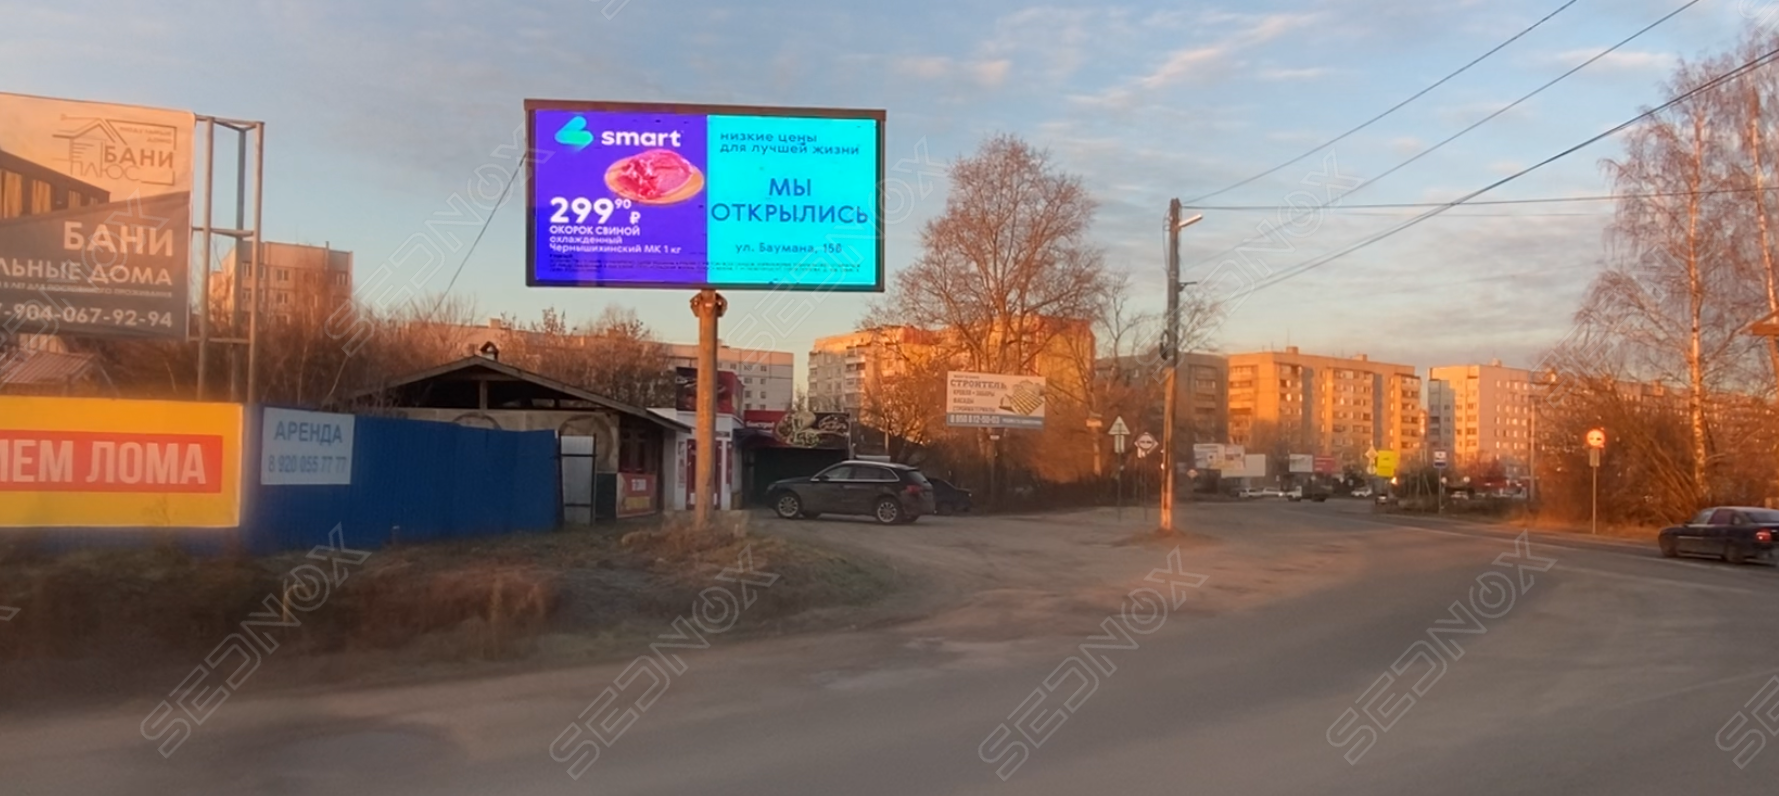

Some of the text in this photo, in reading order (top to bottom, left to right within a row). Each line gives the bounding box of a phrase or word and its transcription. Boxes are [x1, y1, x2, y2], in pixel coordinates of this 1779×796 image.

[601, 130, 682, 147] smart
[720, 132, 818, 146] низкие цены
[104, 145, 174, 169] БАНИ
[720, 143, 859, 155] для лучшей жизни
[70, 160, 141, 181] ПЛЮС
[769, 178, 811, 196] МЫ
[550, 197, 614, 224] 299
[615, 199, 632, 209] 90
[711, 203, 868, 223] ОТКРЫЛИСЬ
[64, 221, 174, 257] БАНИ
[549, 225, 640, 236] ОКОРОК СВИНОЙ
[549, 236, 623, 245] охлажденный
[644, 245, 661, 254] МК
[736, 244, 755, 253] ул.
[759, 242, 819, 254] Баумана,
[87, 264, 173, 287] ДОМА
[950, 379, 1008, 390] СТРОИТЕЛЬ
[273, 420, 343, 446] АРЕНДА
[86, 441, 207, 485] ЛОМА
[268, 454, 275, 473] 8
[278, 454, 297, 473] 920
[321, 455, 333, 473] 77
[335, 456, 348, 473] 77
